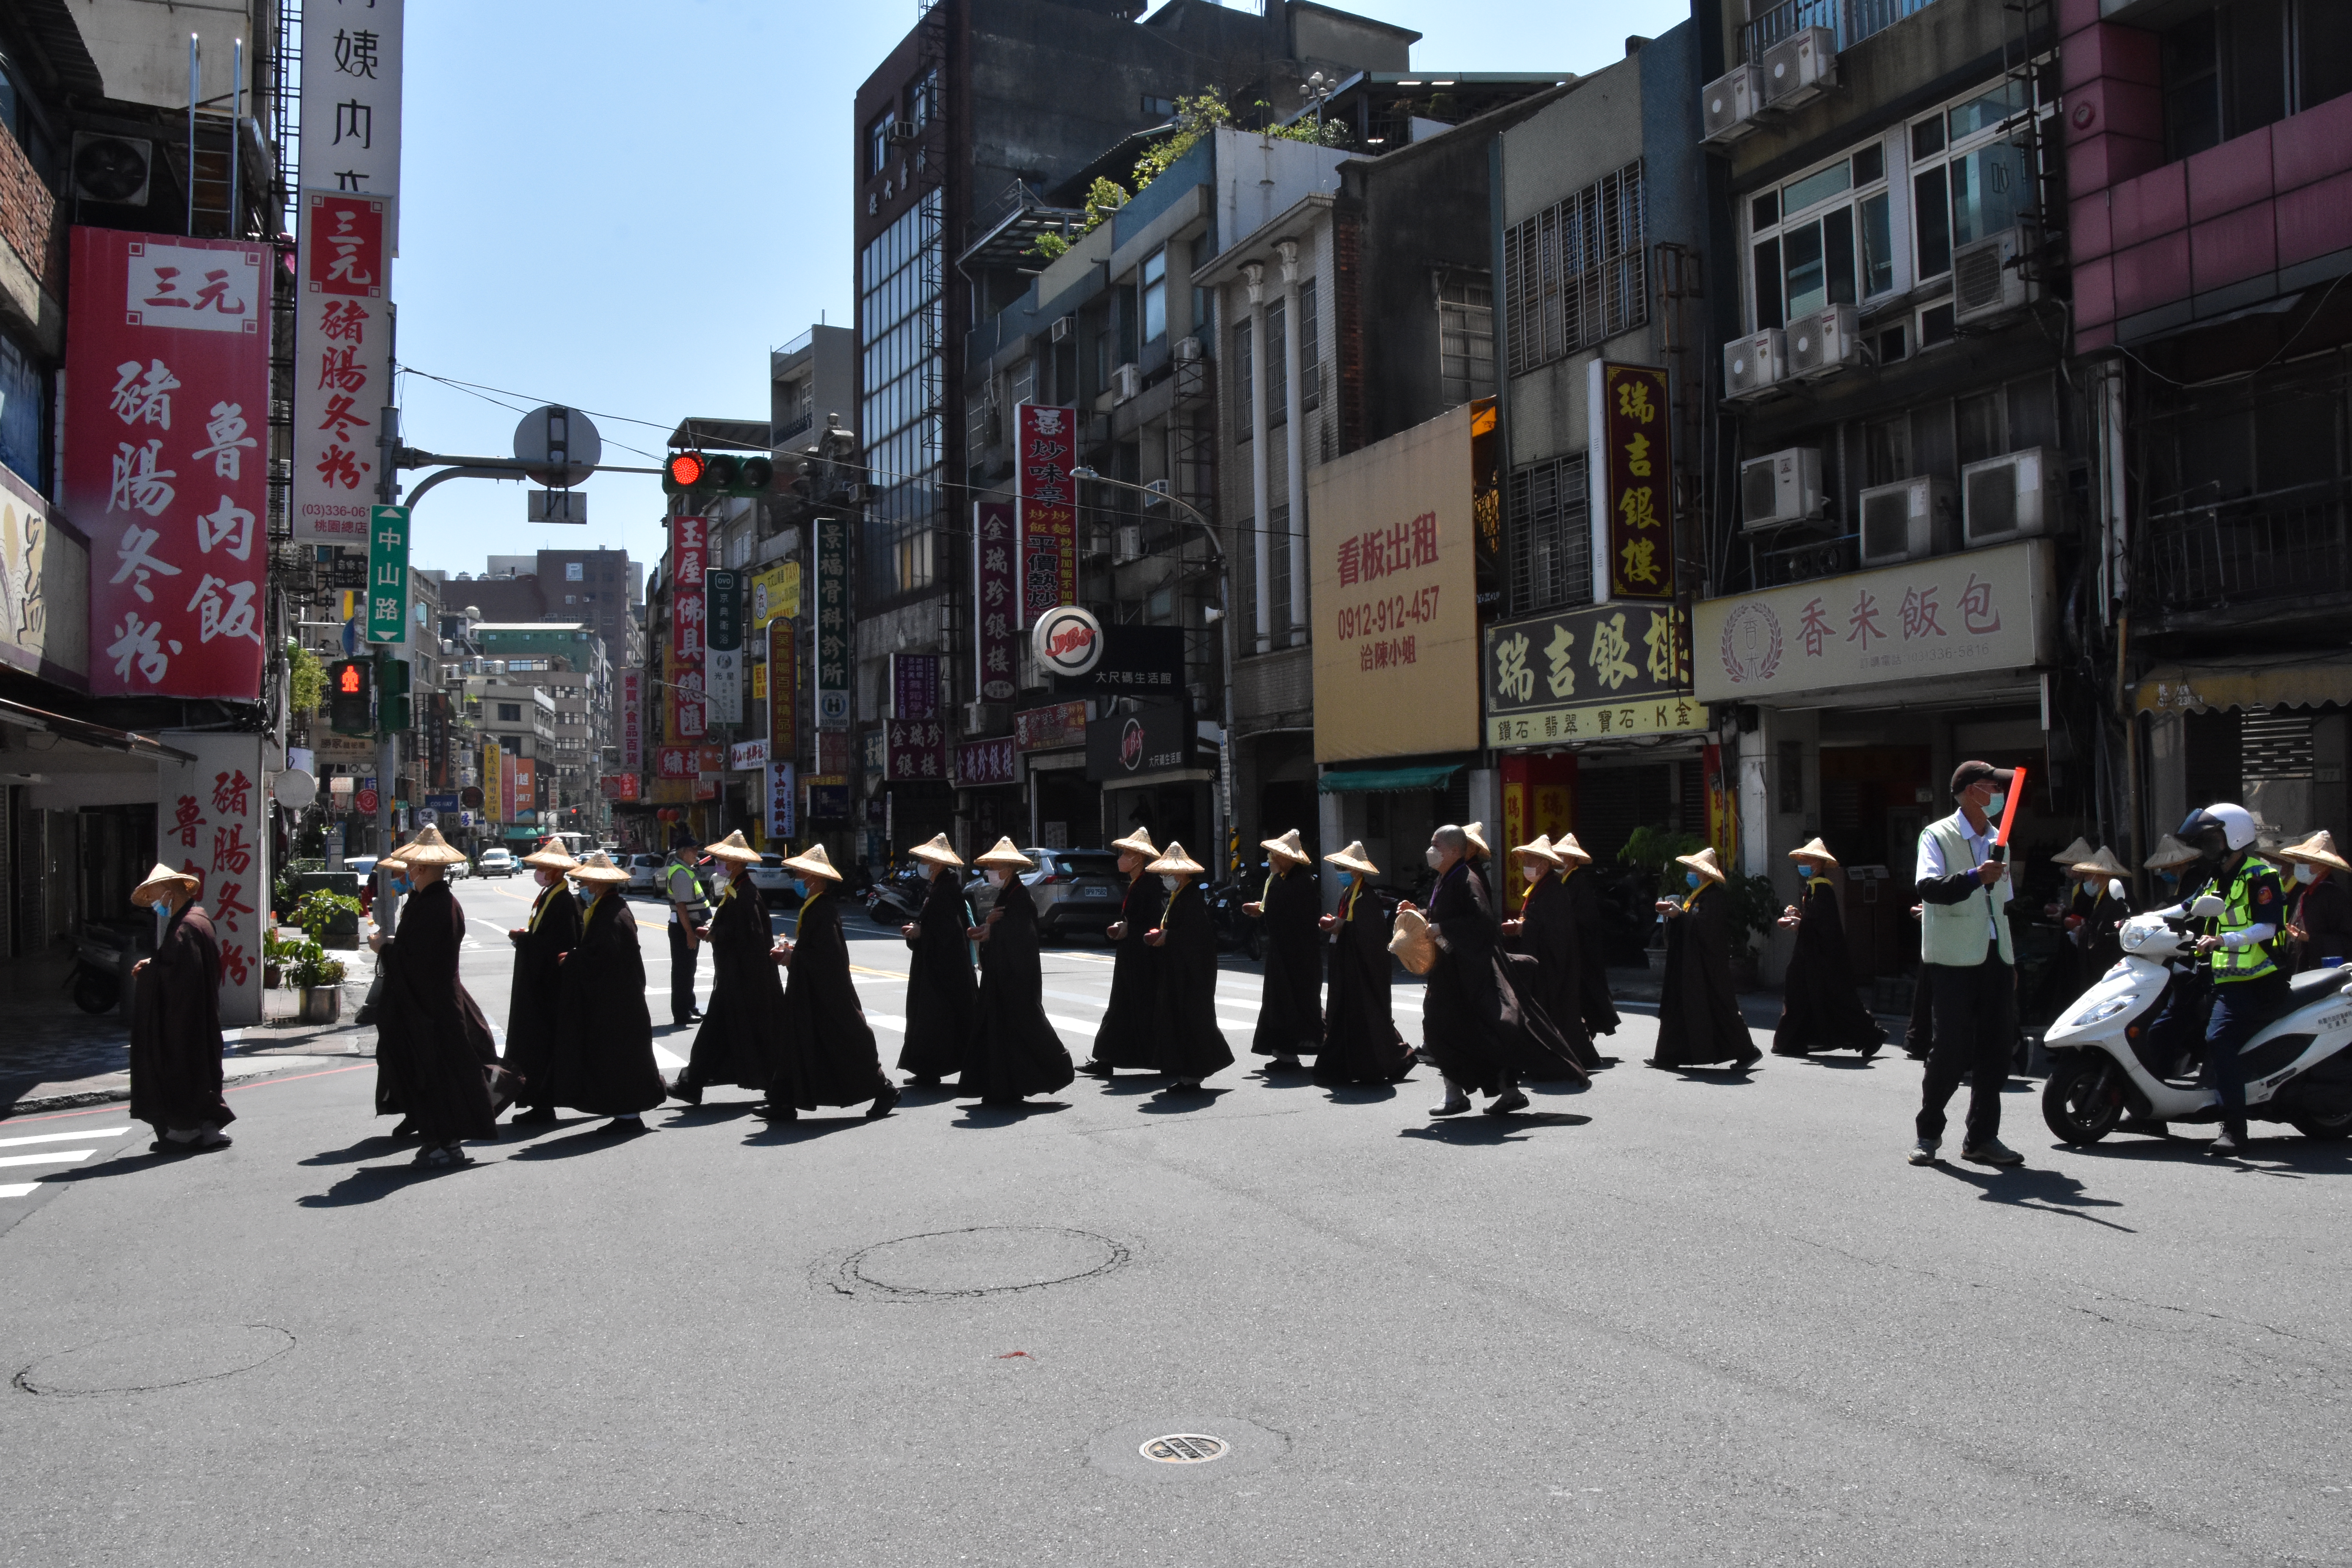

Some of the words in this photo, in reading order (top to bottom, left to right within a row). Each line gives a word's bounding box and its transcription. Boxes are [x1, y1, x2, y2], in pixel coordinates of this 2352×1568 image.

[332, 0, 379, 192] 姨內
[327, 211, 372, 285] 三元
[143, 267, 245, 314] 三元
[316, 300, 371, 490] 豬腸冬粉
[1029, 439, 1069, 508] 炒味亭
[106, 359, 182, 684] 豬腸冬粉
[187, 401, 261, 645] 魯肉飯
[314, 519, 367, 534] 桃園總店
[1337, 511, 1439, 588] 看板出租
[375, 527, 401, 622] 中山路
[820, 524, 847, 686] 景福骨科診所
[1027, 535, 1058, 609] 平價熱炒
[719, 594, 729, 644] 京典衛浴
[1338, 586, 1440, 640] 0912-912-457
[1795, 573, 2002, 657] 香米飯包
[1096, 671, 1172, 686] 大尺碼生活館
[1360, 635, 1417, 673] 洽陳小姐
[625, 711, 638, 765] 食品百貨
[516, 773, 528, 786] 越
[211, 769, 256, 987] 豬腸冬粉
